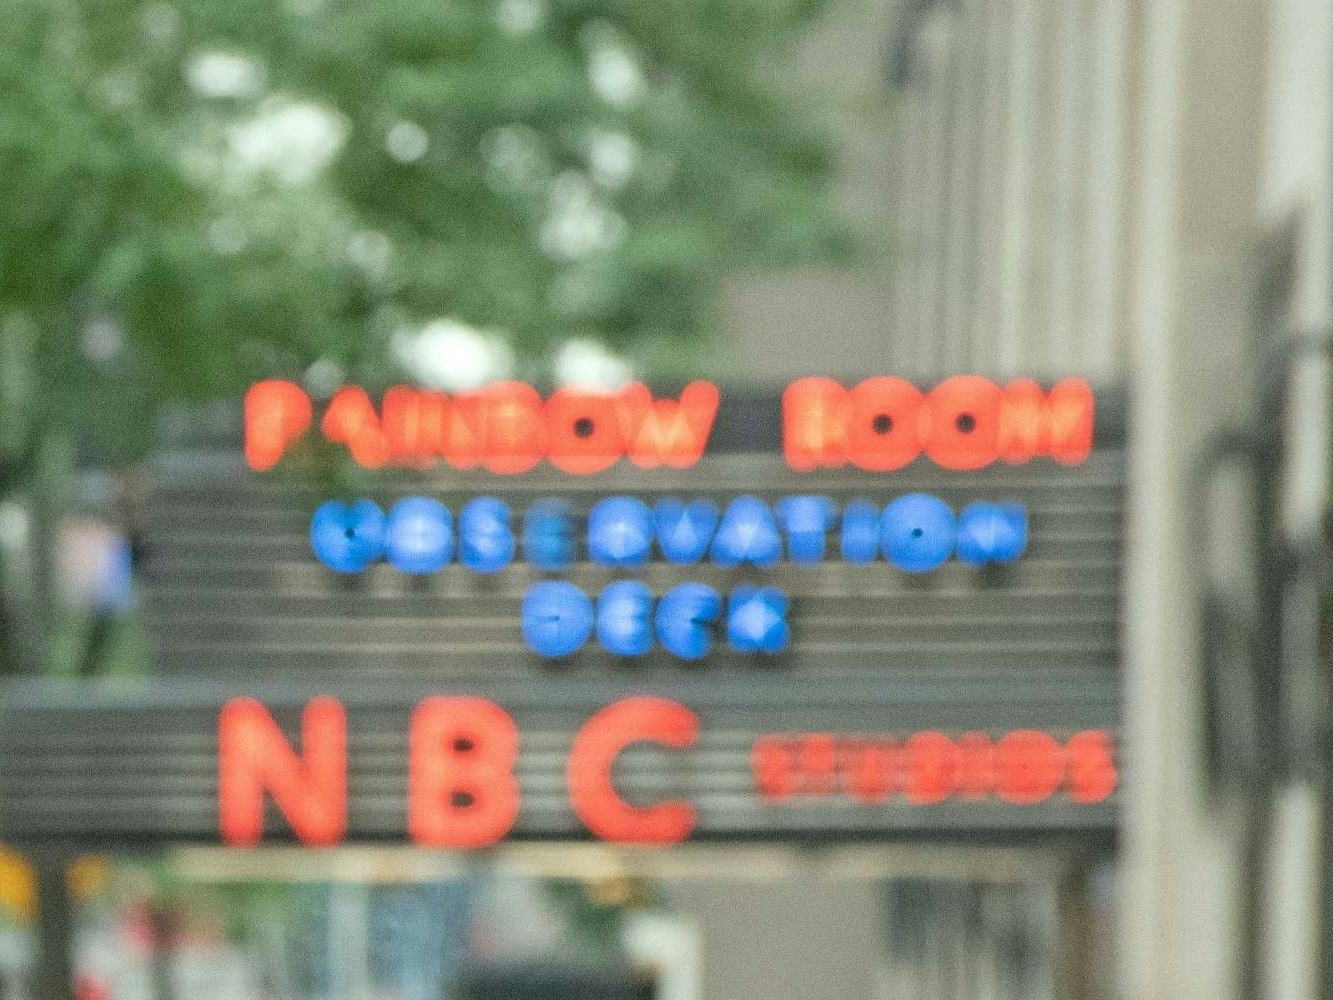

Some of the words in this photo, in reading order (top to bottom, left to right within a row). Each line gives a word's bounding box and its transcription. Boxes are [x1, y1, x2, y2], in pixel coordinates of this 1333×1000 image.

[782, 376, 1095, 472] ROOM
[309, 493, 1030, 575] OBSERVATION
[521, 580, 792, 661] DECK
[218, 695, 701, 851] NBC
